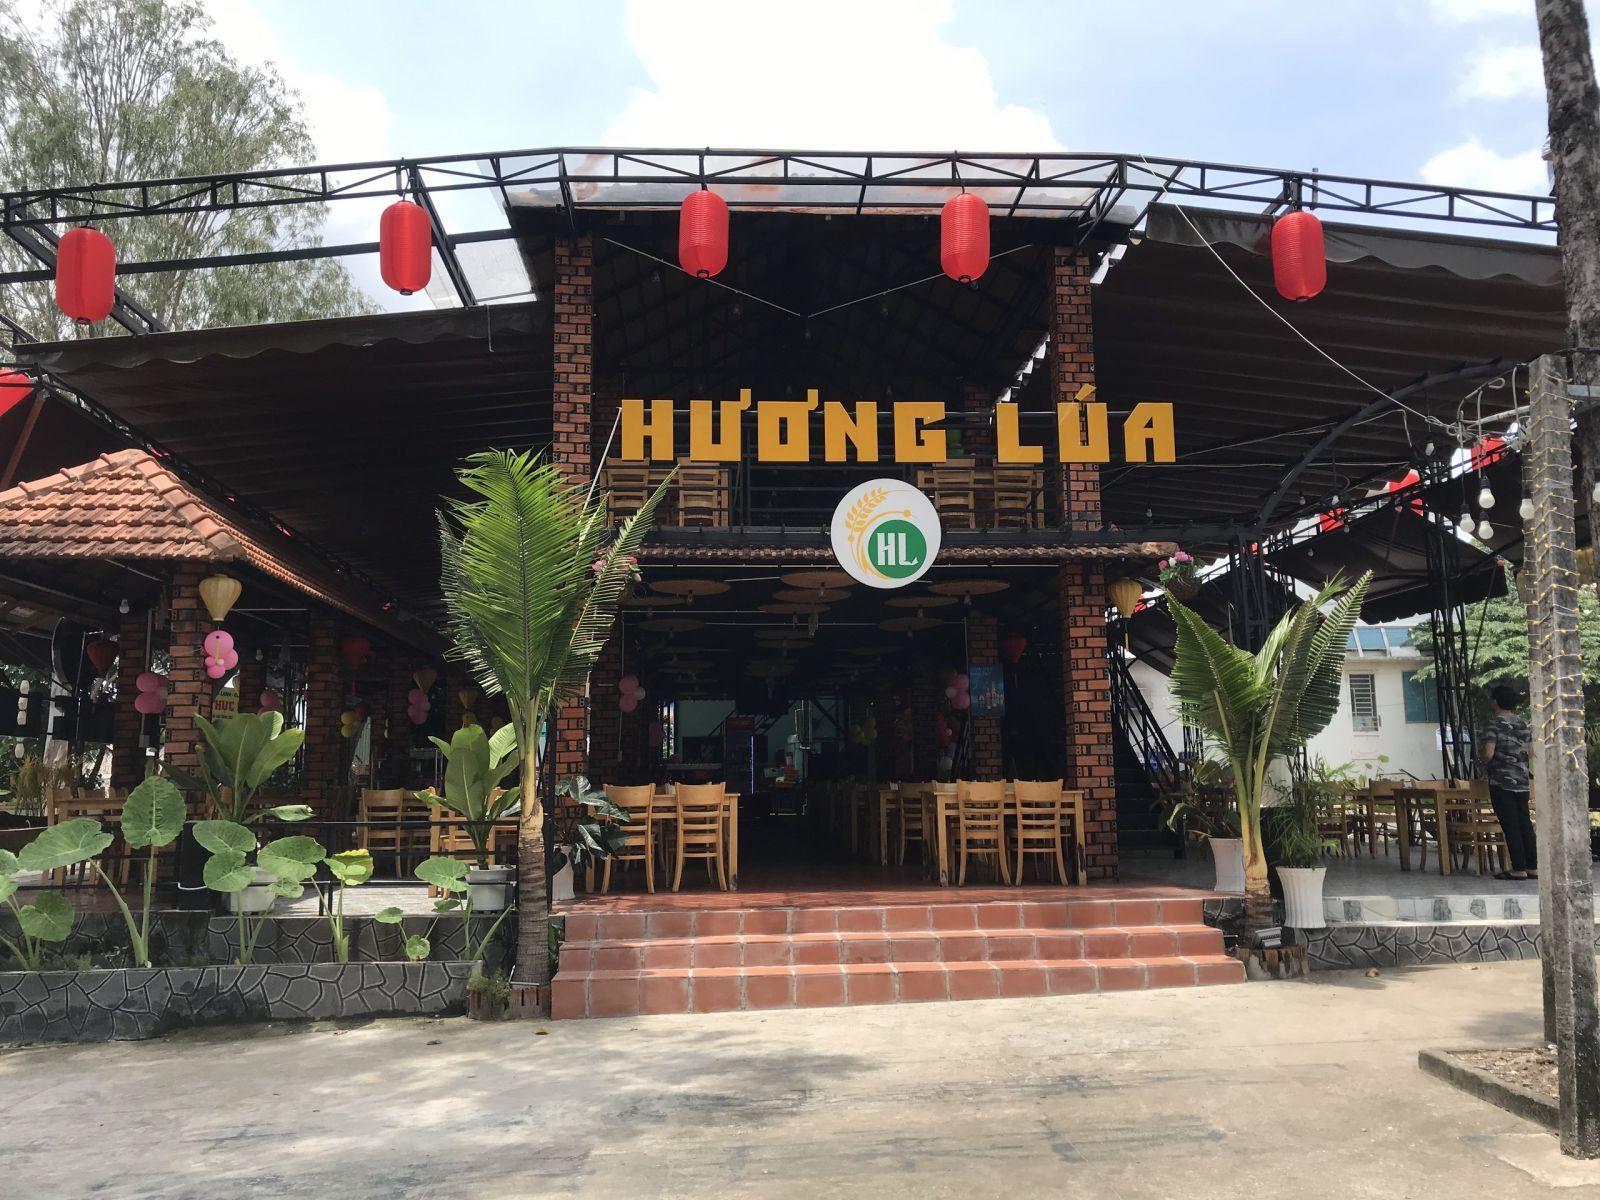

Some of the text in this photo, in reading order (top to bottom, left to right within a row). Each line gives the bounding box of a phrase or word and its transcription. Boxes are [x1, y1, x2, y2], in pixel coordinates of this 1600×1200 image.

[621, 383, 1177, 463] HƯƠNG LÚA
[876, 532, 919, 566] HL
